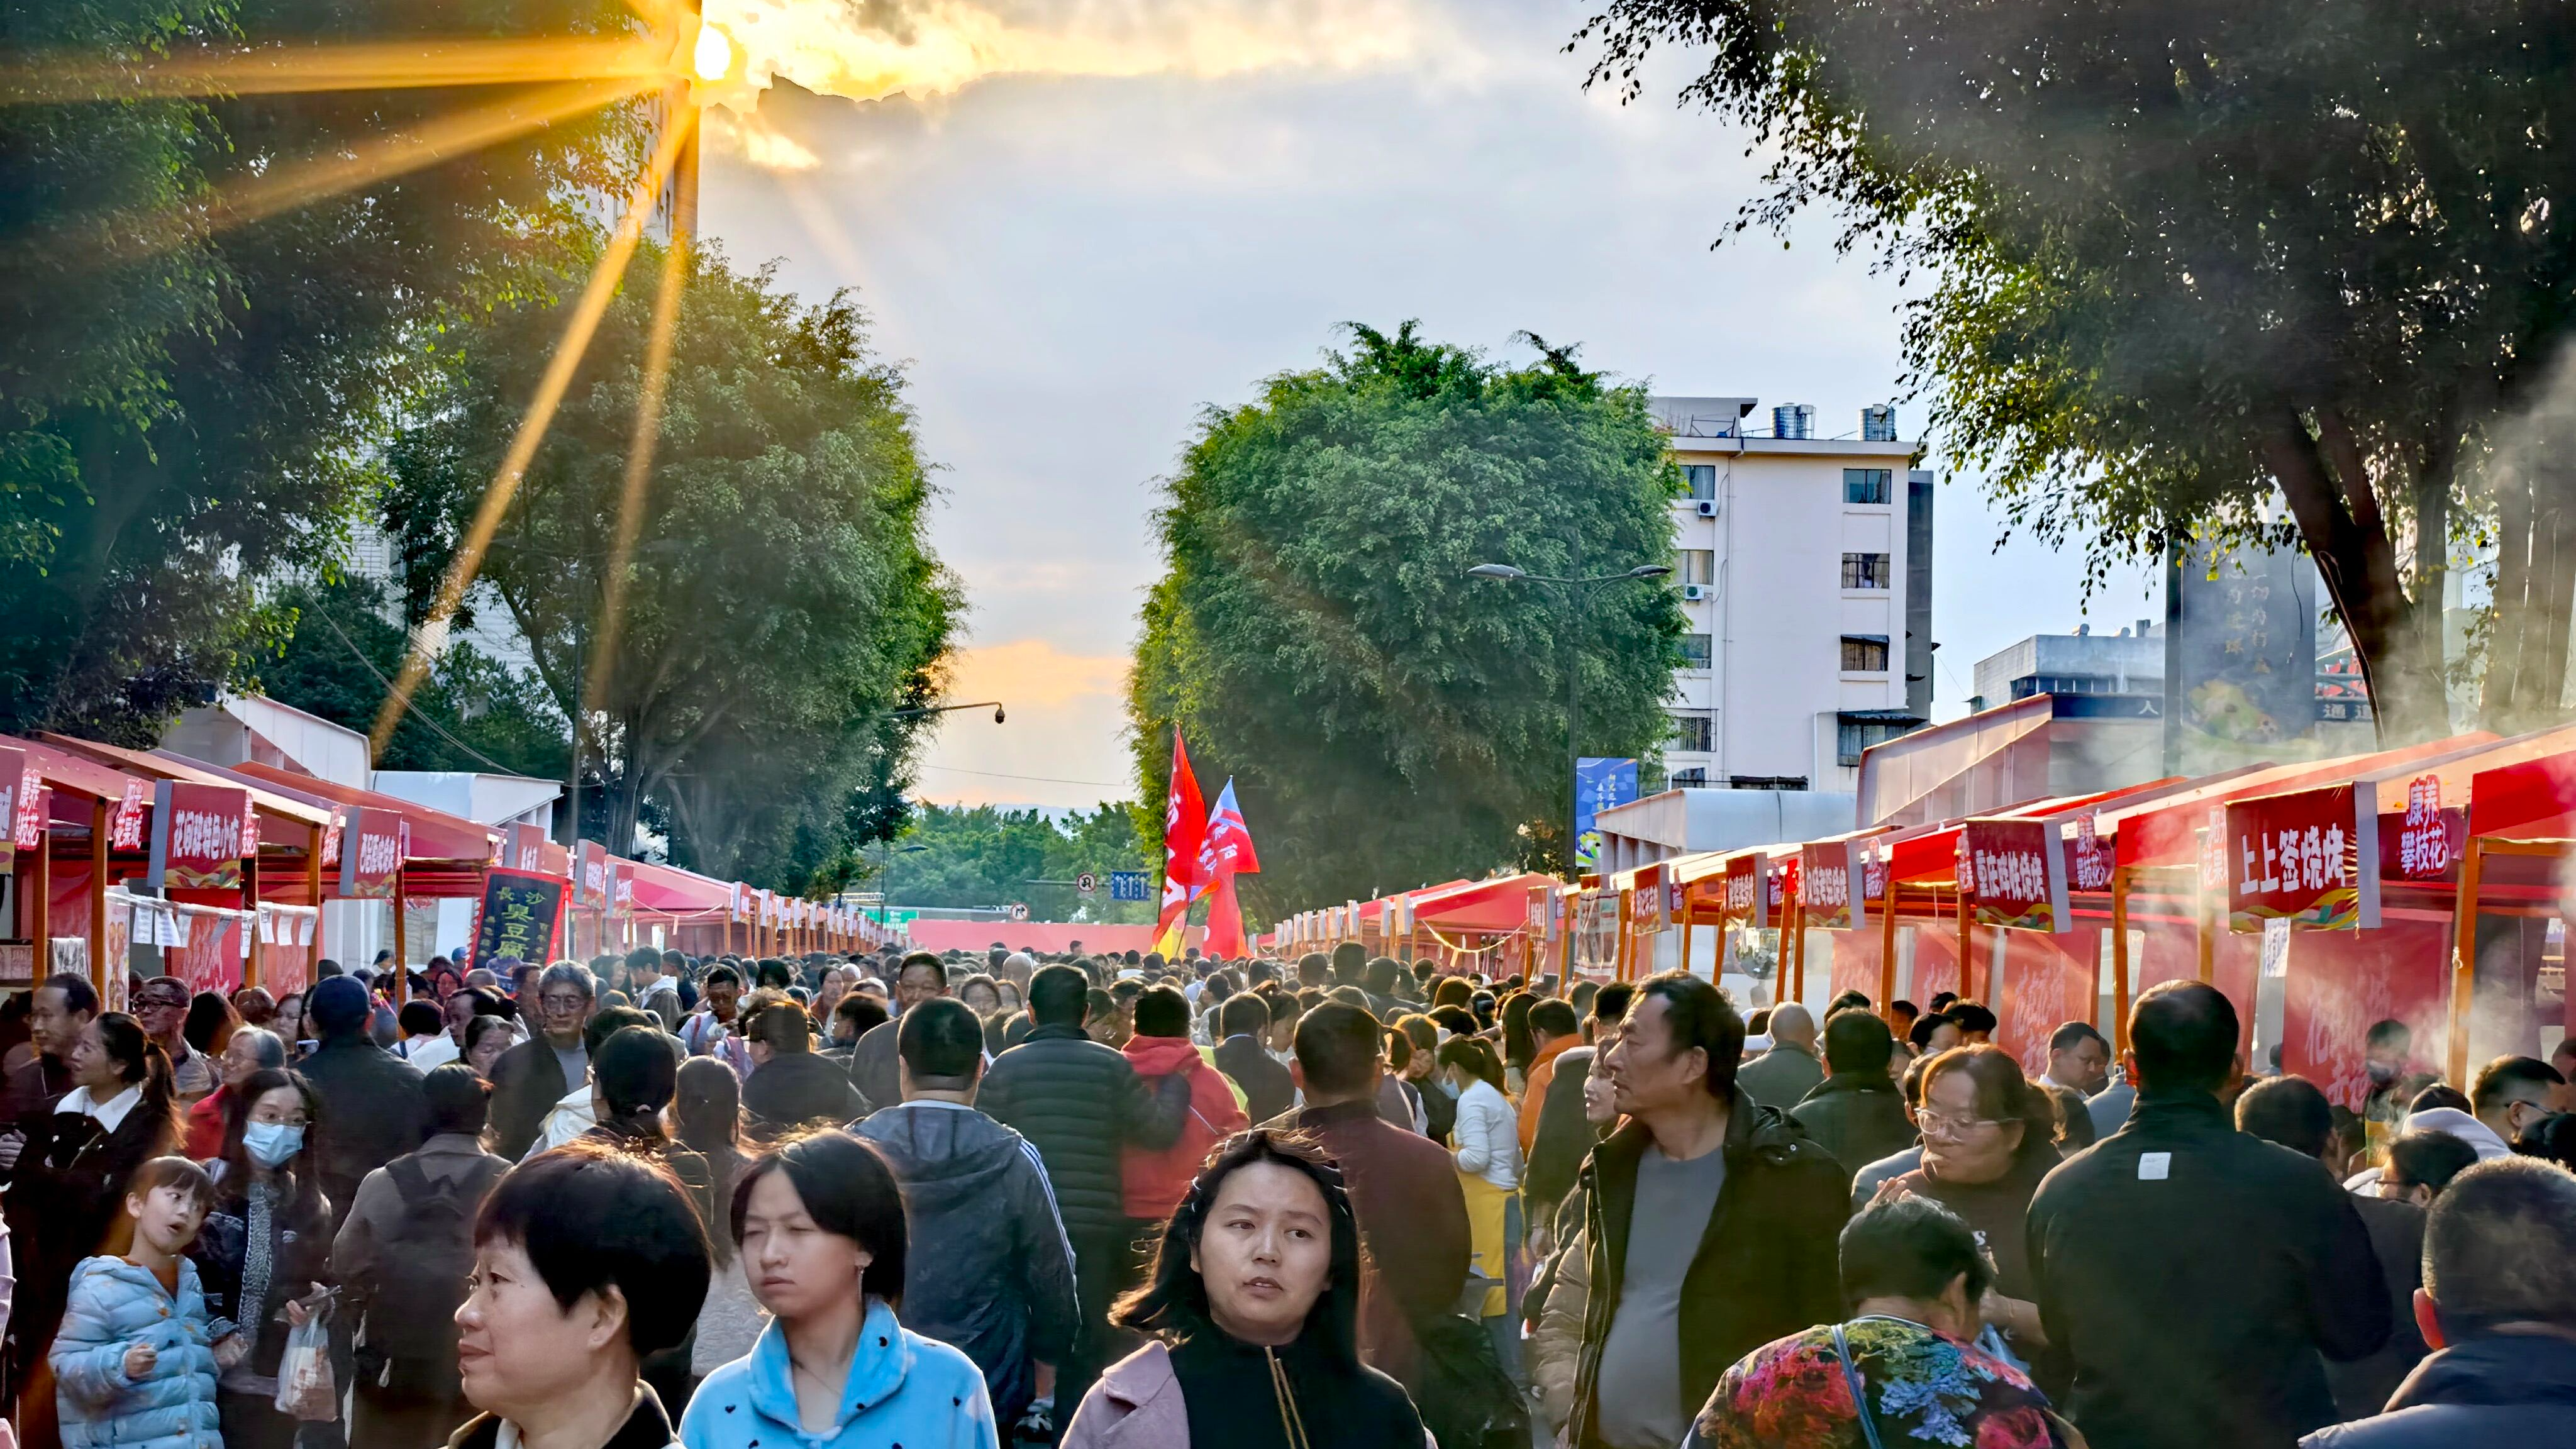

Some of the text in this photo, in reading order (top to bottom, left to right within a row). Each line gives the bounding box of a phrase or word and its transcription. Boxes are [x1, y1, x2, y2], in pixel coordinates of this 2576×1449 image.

[2139, 700, 2159, 715] 人
[2407, 780, 2438, 828] 康养
[2077, 852, 2106, 889] 攀枝花
[2203, 847, 2228, 886] 花果
[2240, 823, 2346, 894] 上上签烧烤
[2401, 826, 2446, 874] 攀枝花
[493, 903, 535, 960] 臭豆腐
